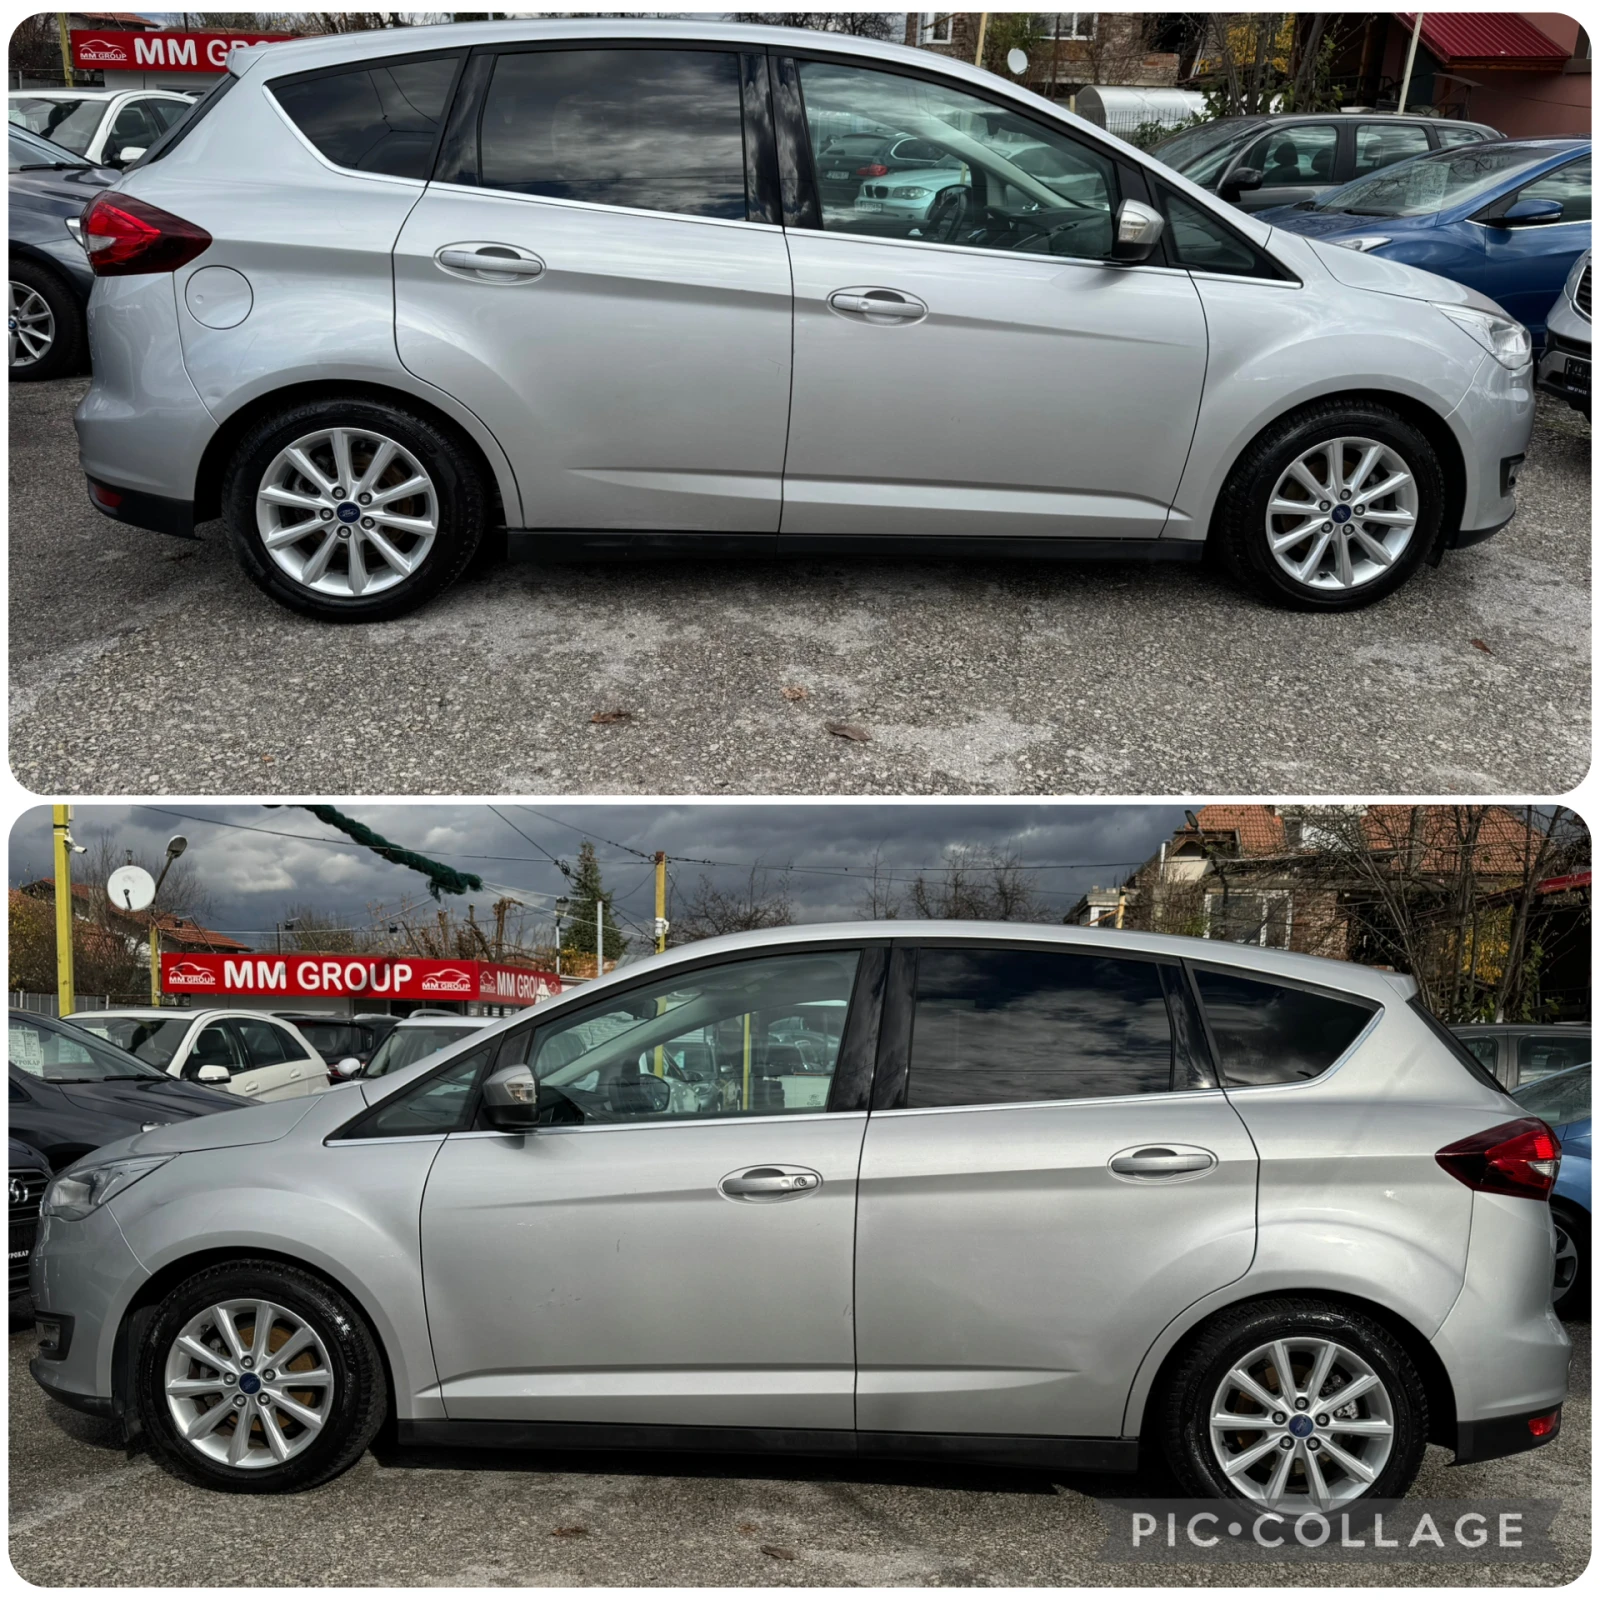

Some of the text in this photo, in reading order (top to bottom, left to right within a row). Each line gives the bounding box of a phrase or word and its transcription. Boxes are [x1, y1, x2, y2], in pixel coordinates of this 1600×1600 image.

[133, 37, 198, 66] MM
[169, 976, 216, 985] MM GROUP
[223, 960, 413, 993] MM GROUP
[421, 982, 439, 991] MM
[440, 982, 471, 991] GROUP
[496, 970, 546, 999] MM GROU
